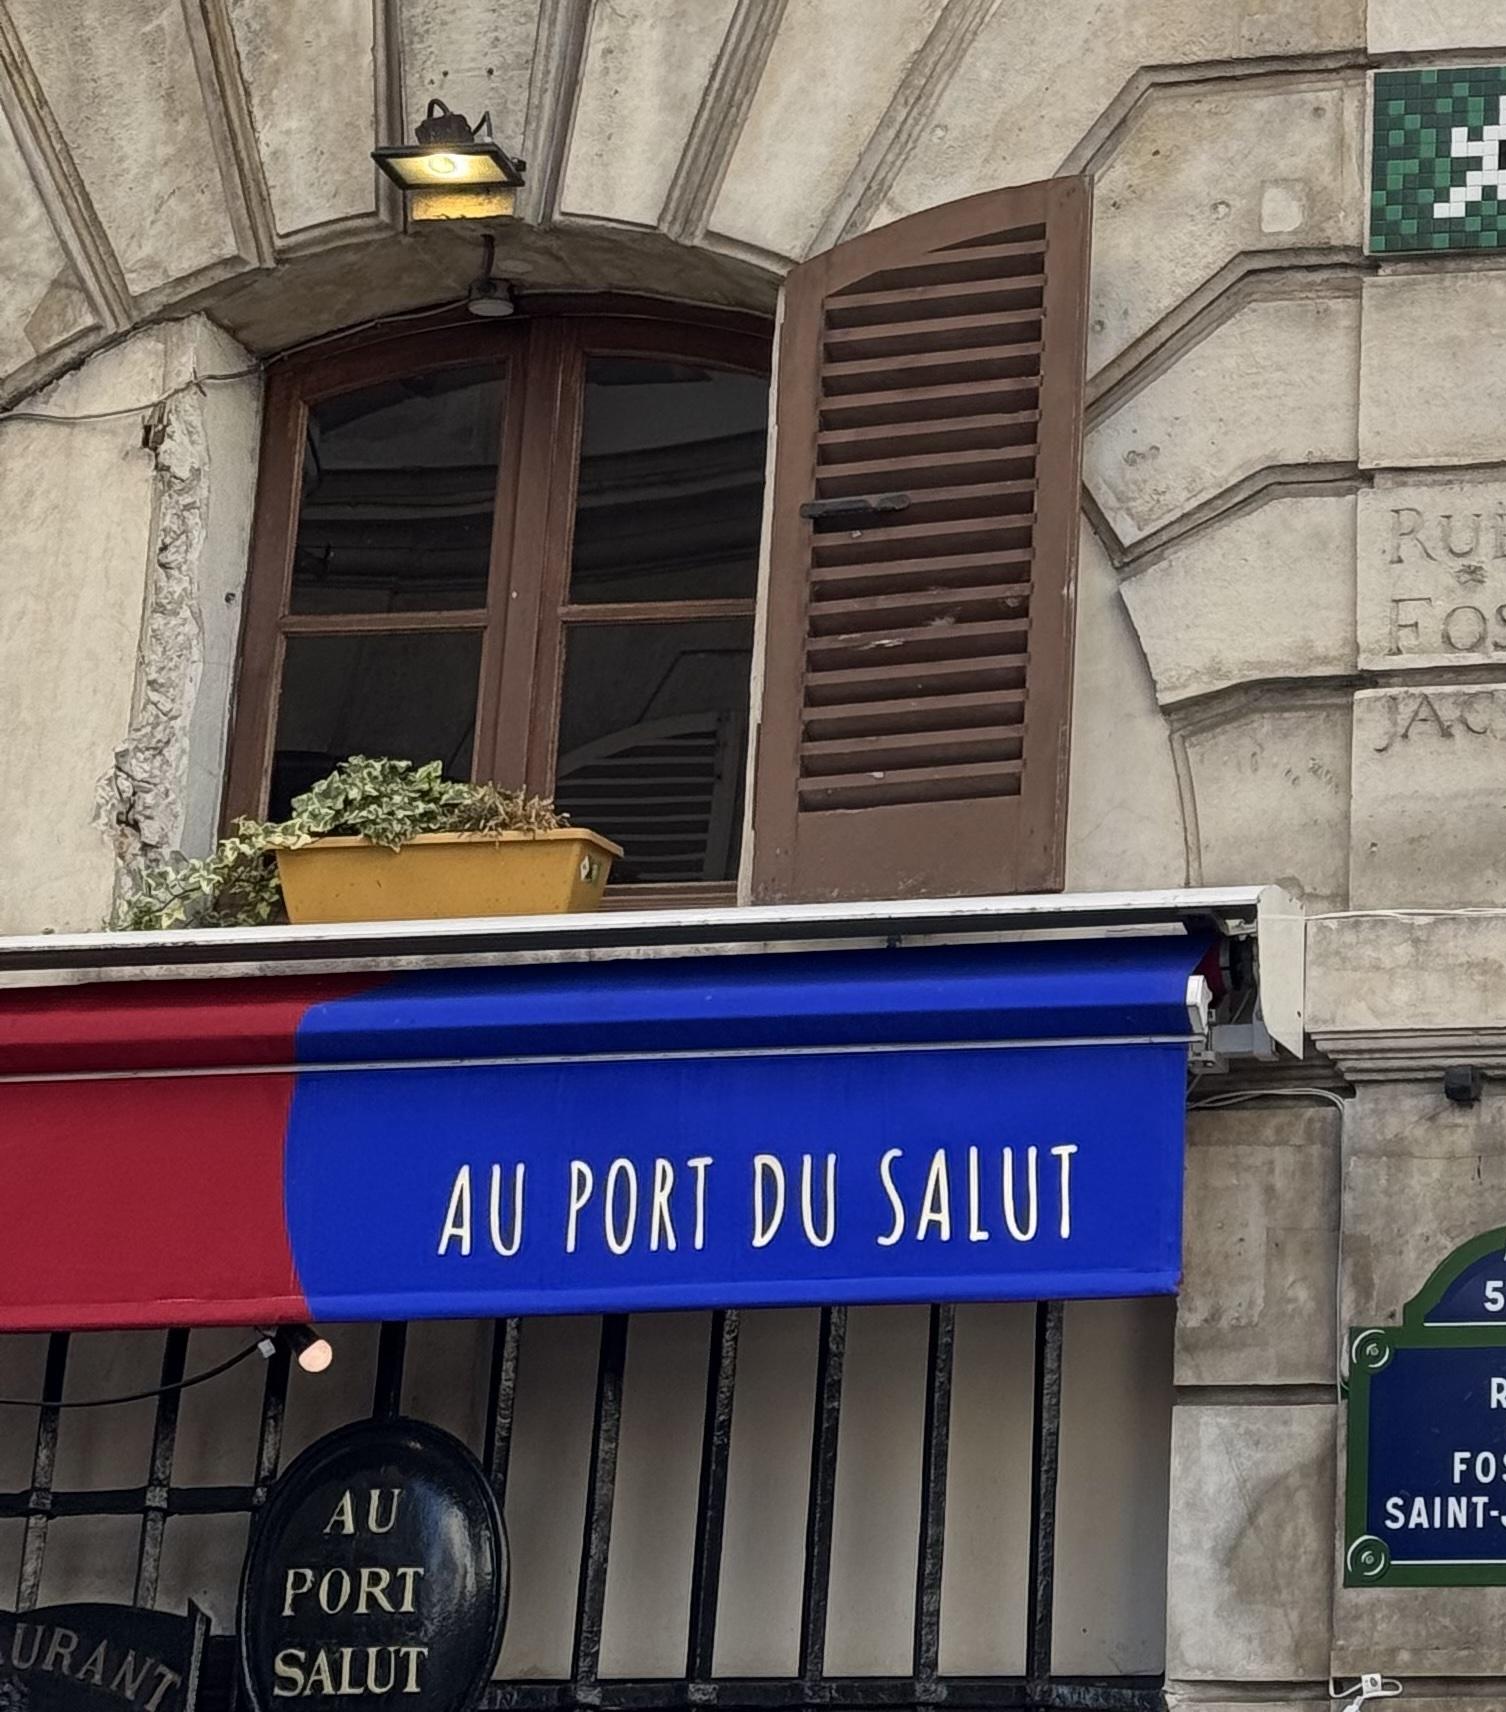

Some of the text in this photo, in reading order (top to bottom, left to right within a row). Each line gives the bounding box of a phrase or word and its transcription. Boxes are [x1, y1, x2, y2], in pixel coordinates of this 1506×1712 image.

[437, 1144, 1078, 1257] AU PORT DU SALUT
[323, 1488, 401, 1535] AU
[281, 1567, 425, 1617] PORT
[0, 1622, 183, 1711] URANT
[273, 1647, 429, 1697] SALUT
